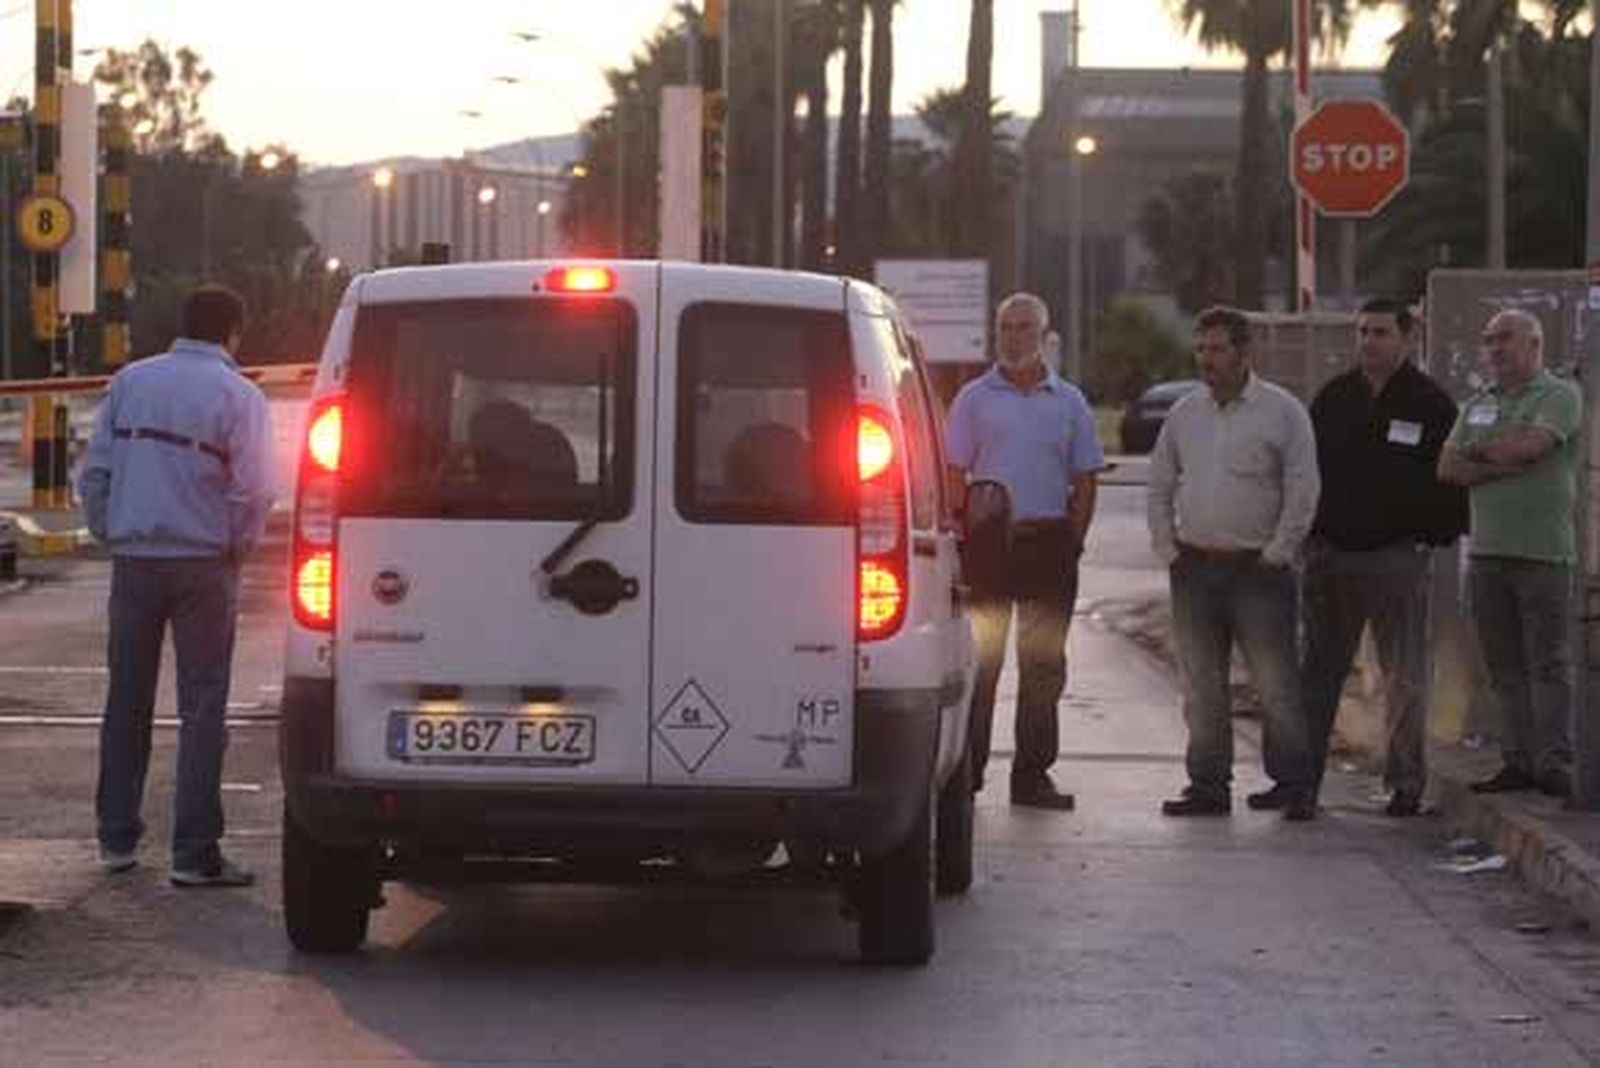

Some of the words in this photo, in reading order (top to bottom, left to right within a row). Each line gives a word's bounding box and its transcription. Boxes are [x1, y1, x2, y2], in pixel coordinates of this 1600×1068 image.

[1301, 144, 1397, 173] STOP
[38, 208, 54, 235] 8
[414, 719, 503, 752] 9367
[515, 720, 585, 754] FCZ
